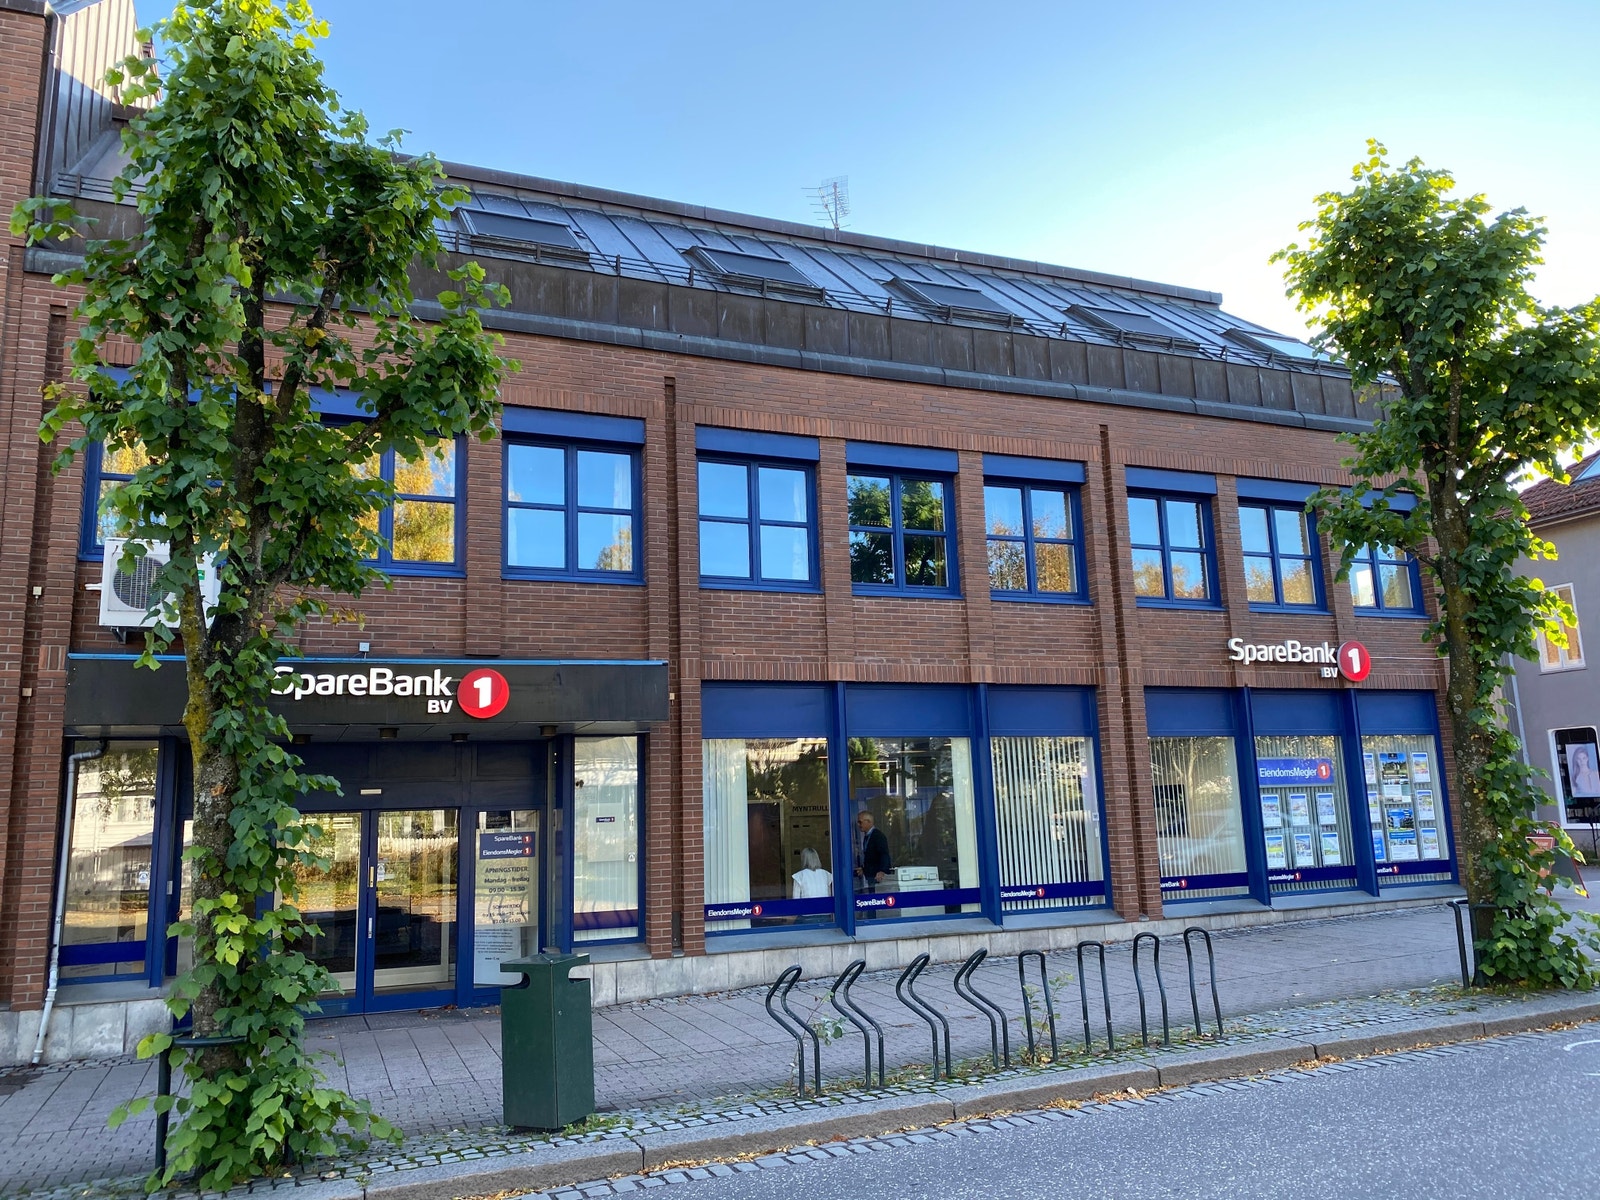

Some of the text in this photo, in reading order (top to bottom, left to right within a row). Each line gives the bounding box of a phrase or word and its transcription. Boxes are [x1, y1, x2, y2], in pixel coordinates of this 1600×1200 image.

[1228, 638, 1361, 674] SpareBank 1
[1321, 667, 1338, 678] BV
[271, 666, 492, 708] SpareBank 1
[427, 699, 452, 713] BV
[1259, 767, 1317, 779] EiendomsMegler
[1000, 890, 1037, 898] EiendomsMegler
[856, 898, 887, 907] SpareBank
[708, 908, 753, 916] EiendomsMegler
